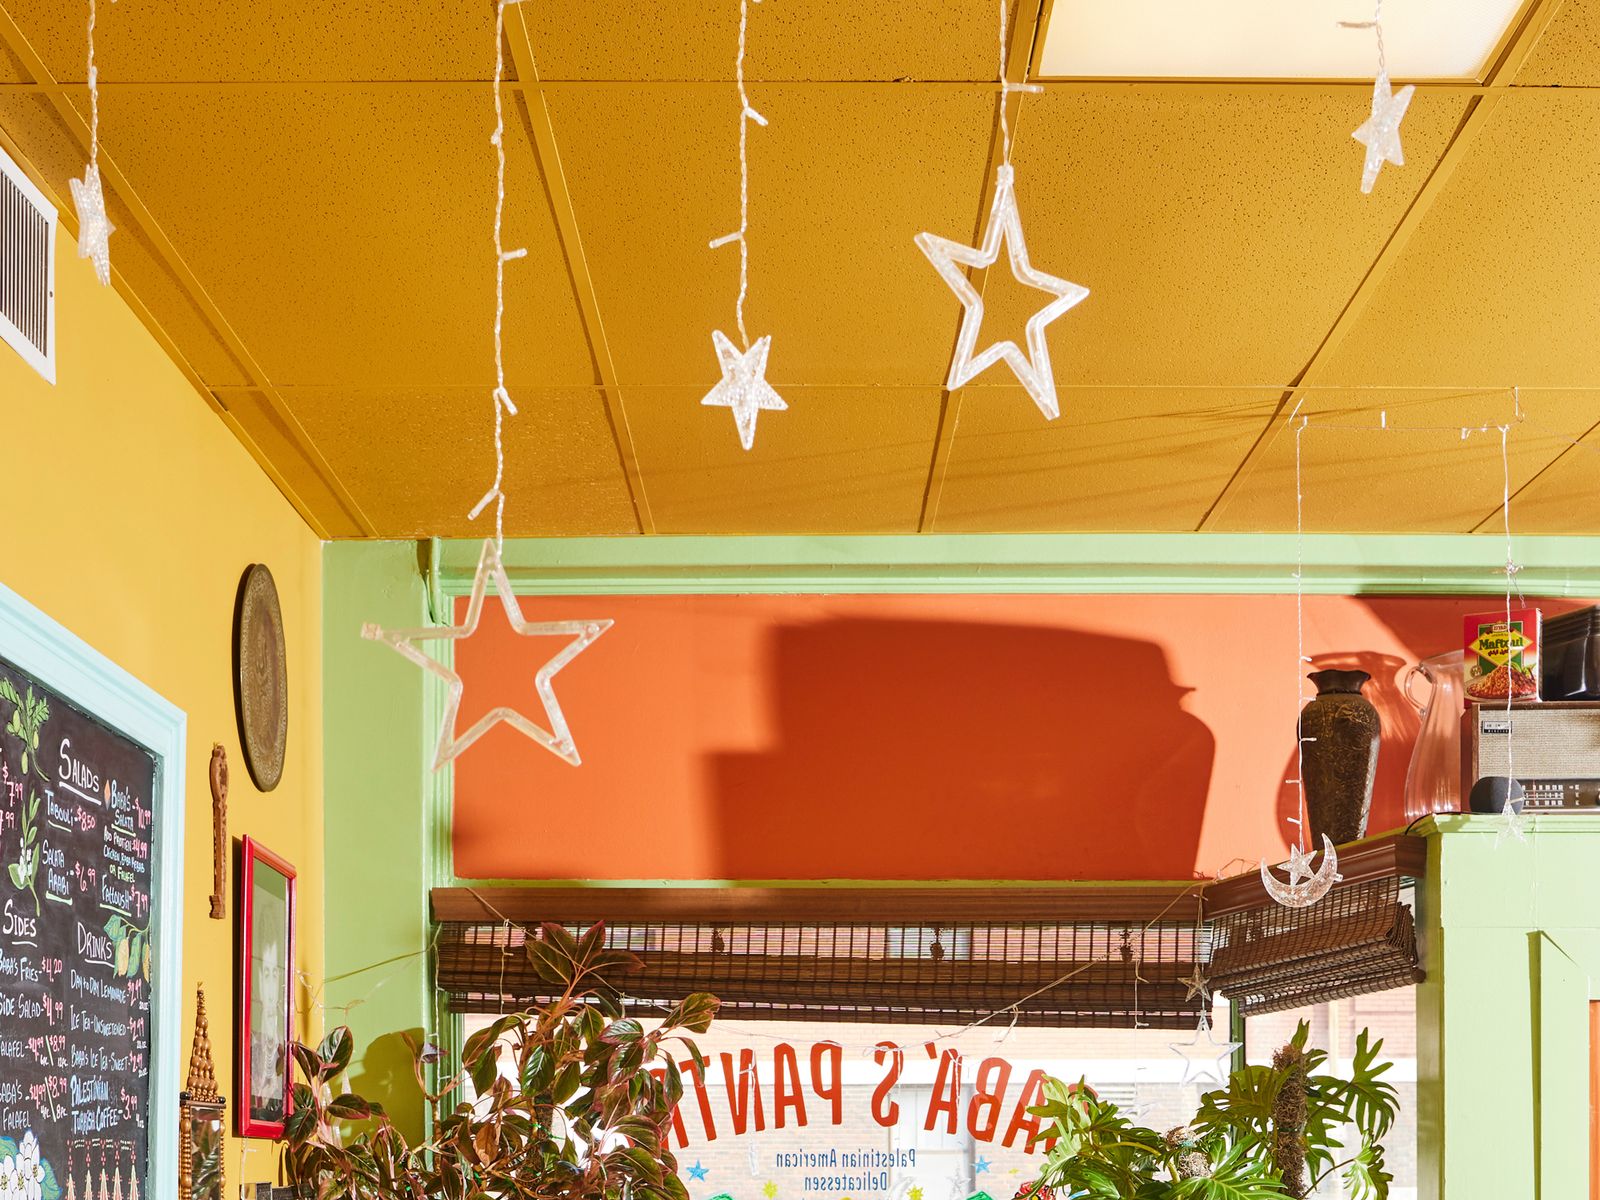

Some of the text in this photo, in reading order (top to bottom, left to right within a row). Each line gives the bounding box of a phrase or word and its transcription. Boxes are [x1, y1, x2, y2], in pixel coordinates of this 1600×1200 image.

[2, 898, 37, 938] SIDES
[77, 921, 113, 960] DRINKS
[0, 1035, 25, 1058] ALAFEL
[0, 1079, 23, 1105] ABA'S
